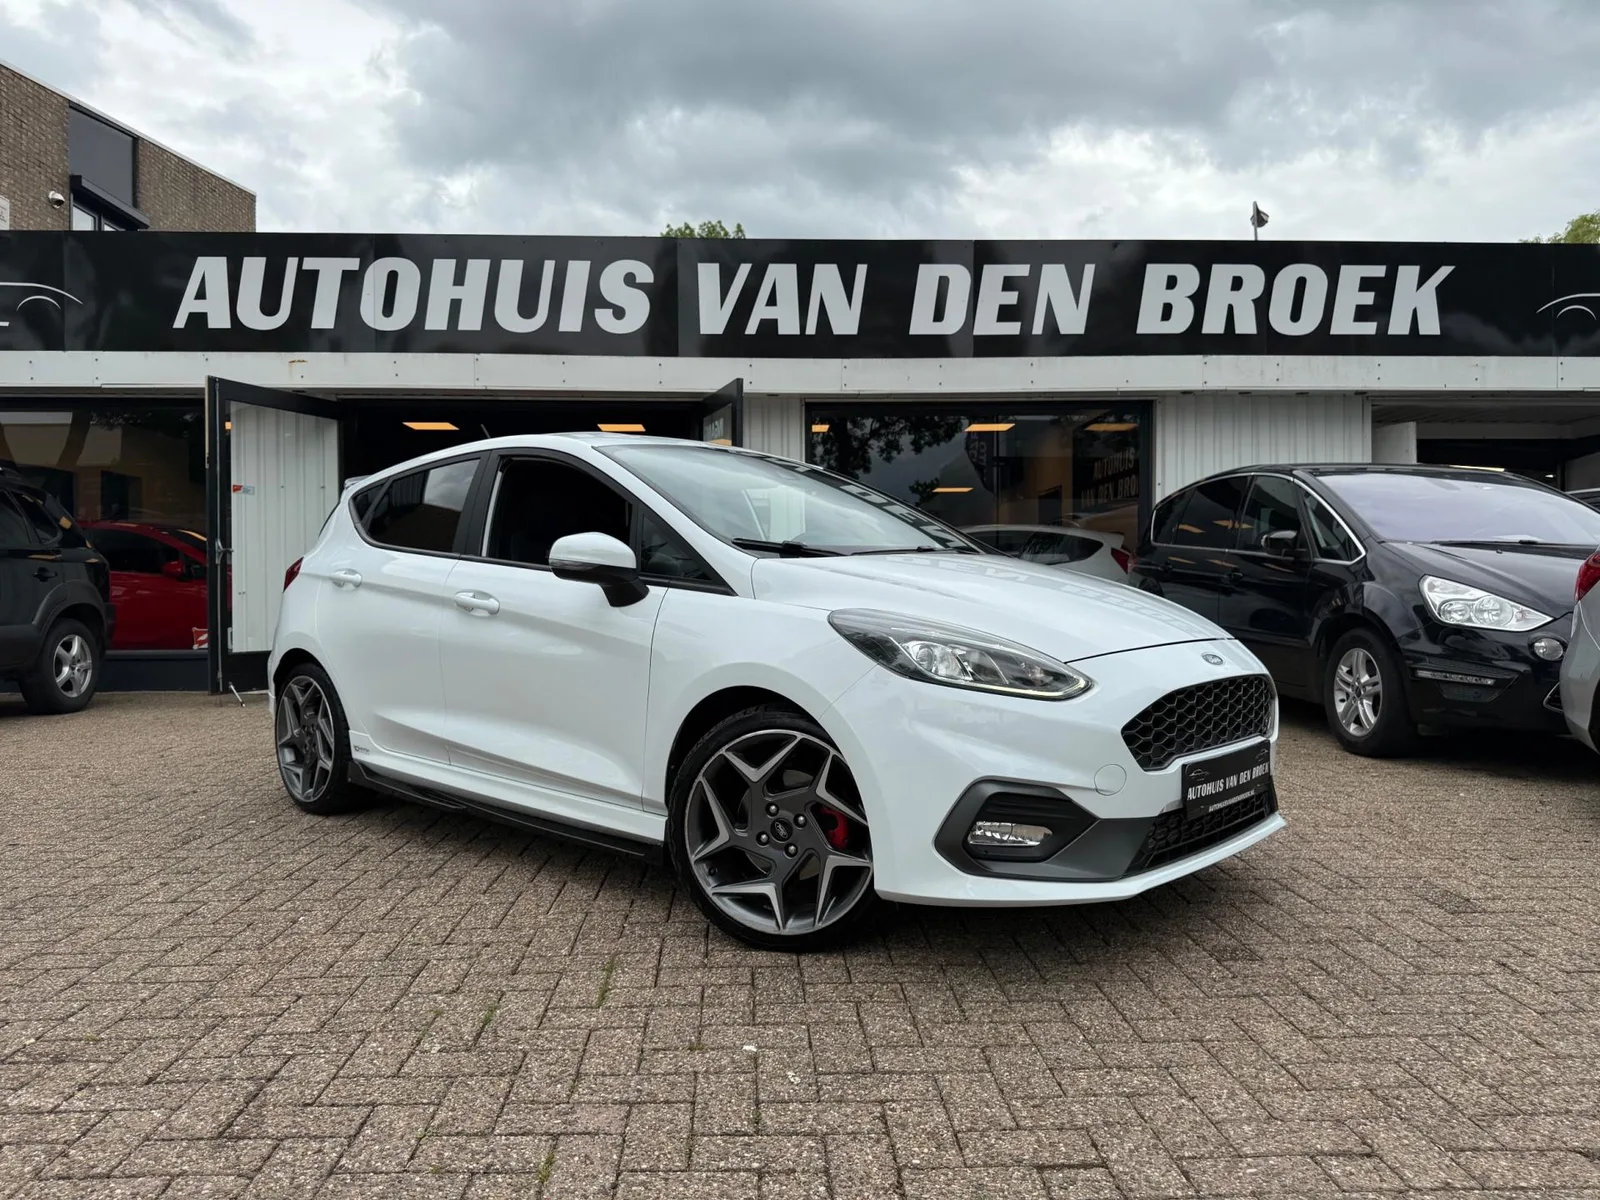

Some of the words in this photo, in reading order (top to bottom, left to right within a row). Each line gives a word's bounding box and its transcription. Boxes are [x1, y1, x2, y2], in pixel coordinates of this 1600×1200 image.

[173, 257, 654, 335] AUTOHUIS
[698, 263, 868, 335] VAN
[909, 263, 1096, 336] DEN
[1137, 263, 1455, 336] BROEK
[1092, 447, 1136, 482] AUTOHUIS
[1187, 779, 1225, 800] AUTOHUIS
[1226, 774, 1239, 790] VAN
[1239, 769, 1252, 784] DEN
[1252, 762, 1270, 779] BROEK
